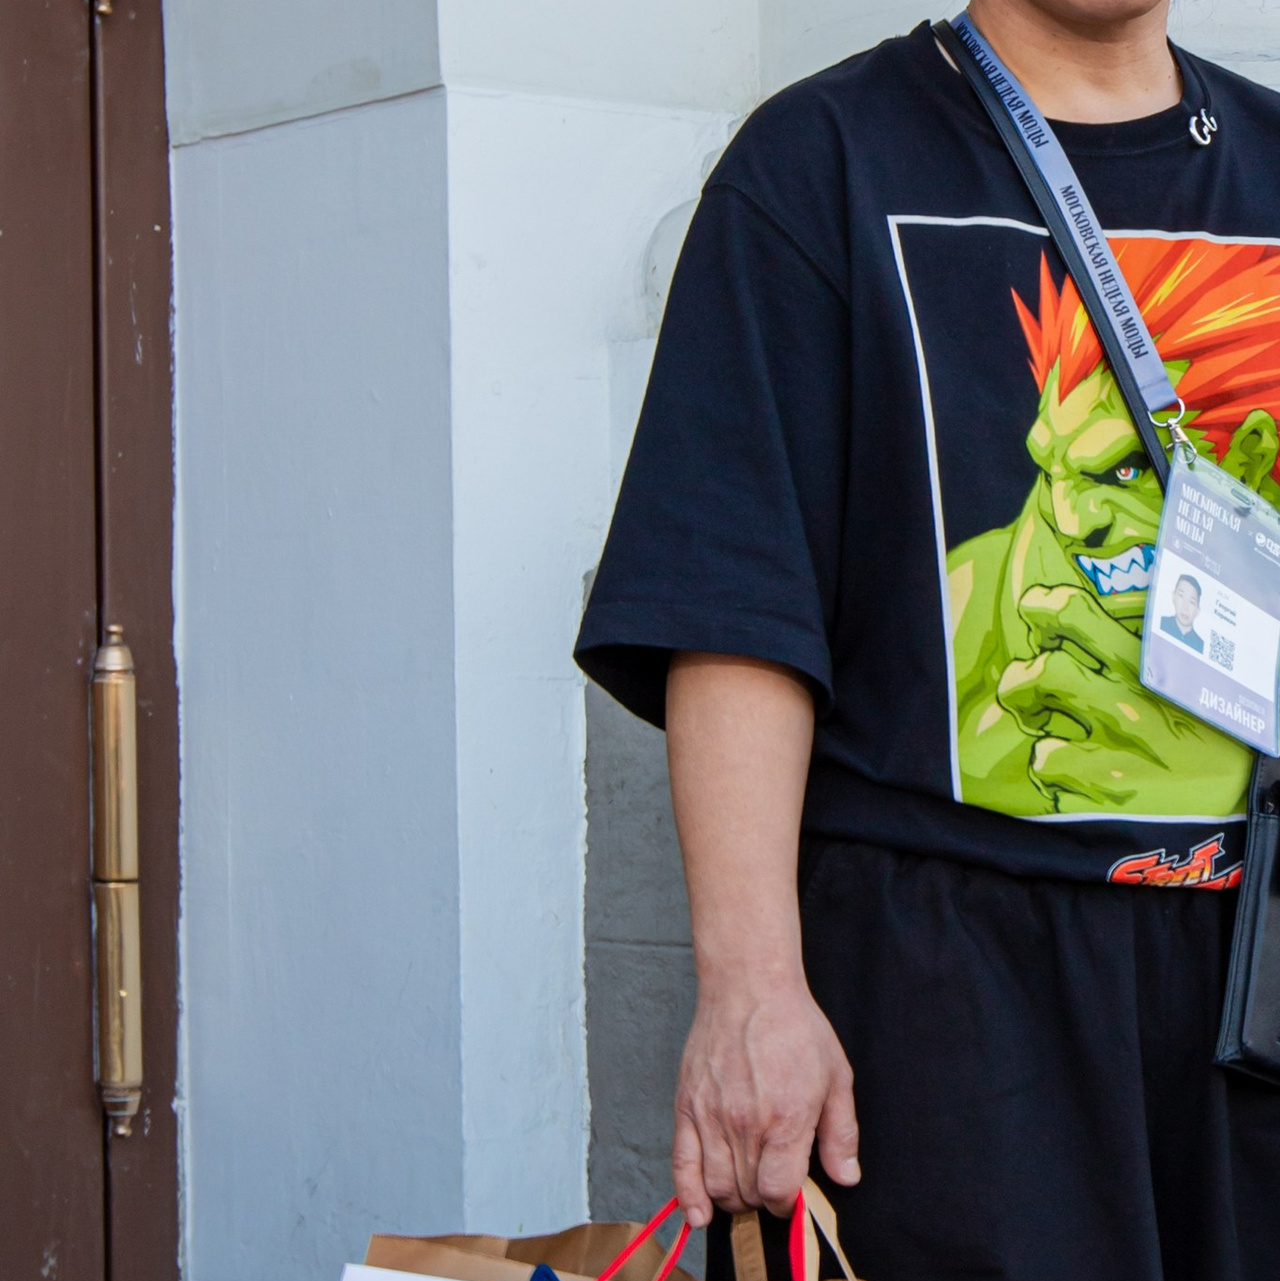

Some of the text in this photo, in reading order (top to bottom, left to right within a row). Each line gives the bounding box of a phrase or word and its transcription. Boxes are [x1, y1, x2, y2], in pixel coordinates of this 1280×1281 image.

[1016, 109, 1050, 148] МОДЫ
[1060, 184, 1149, 359] МОСКОВСКАЯ НЕДЕЛЯ МОДЫ
[1178, 500, 1213, 532] НЕДЕЛЯ
[1181, 483, 1241, 532] МОСКОВСКАЯ
[1176, 516, 1205, 545] МОДЫ
[1199, 687, 1266, 734] ДИЗАЙНЕР
